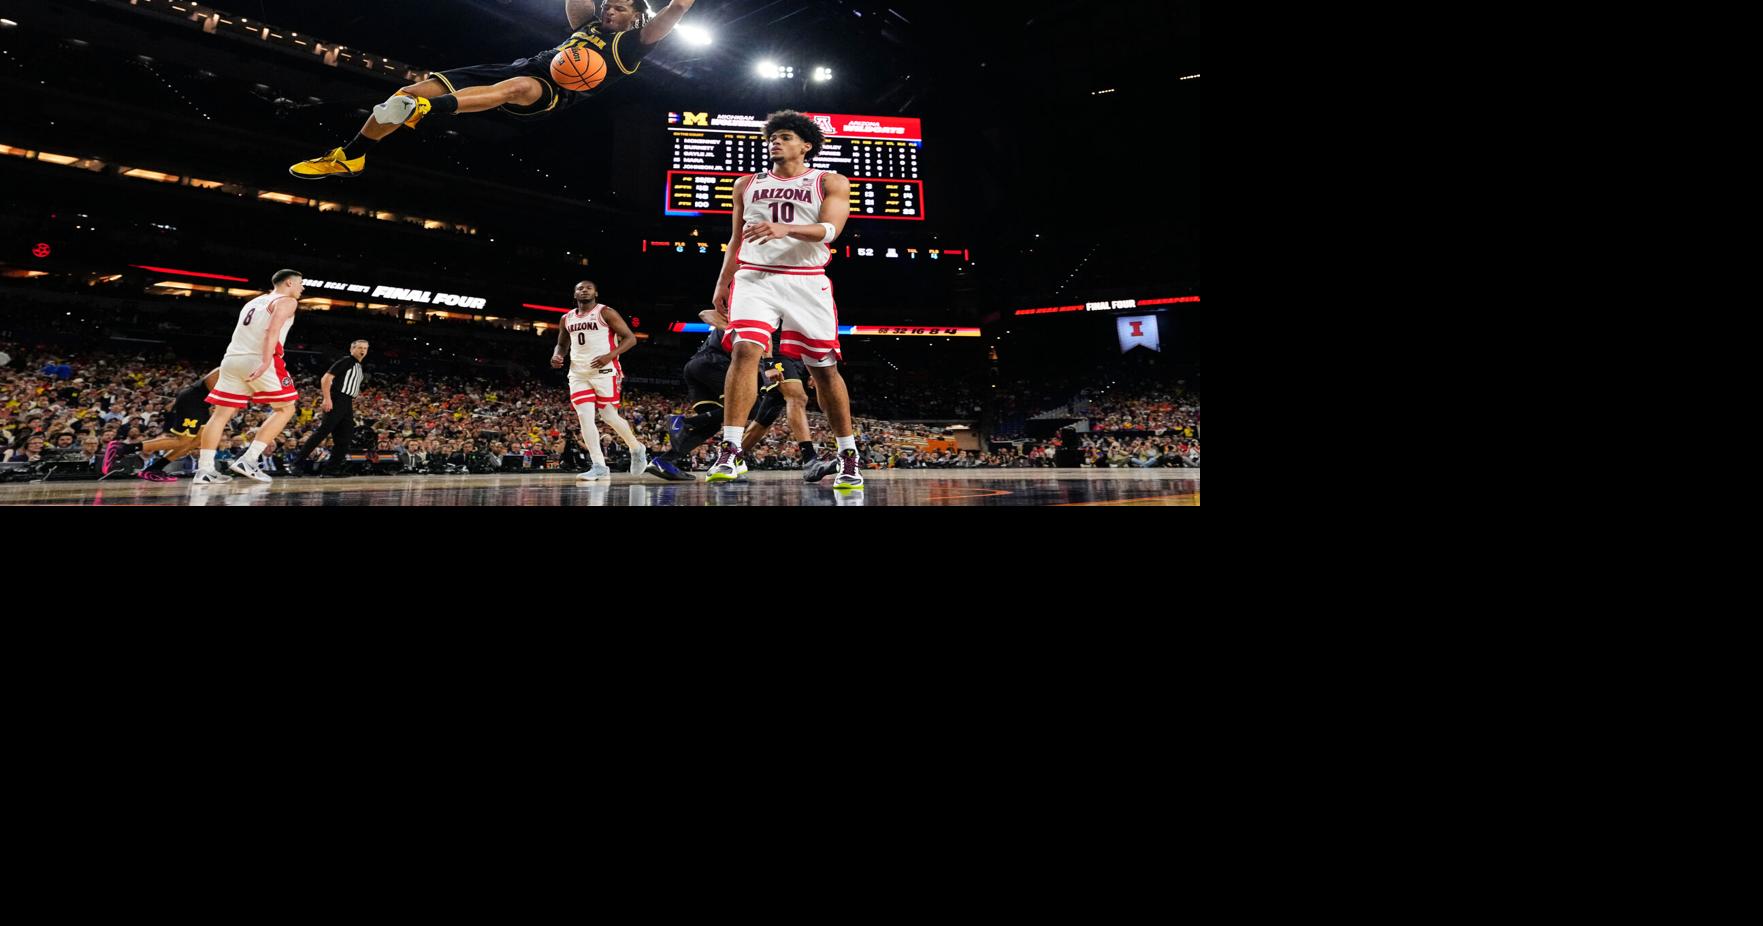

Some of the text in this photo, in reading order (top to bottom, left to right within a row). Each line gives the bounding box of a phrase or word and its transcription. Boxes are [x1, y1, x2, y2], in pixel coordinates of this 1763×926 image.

[682, 112, 708, 126] M
[843, 124, 905, 134] WILDCATS
[752, 188, 812, 204] ARIZONA
[768, 201, 794, 223] 10
[857, 248, 874, 256] 52
[372, 285, 433, 303] FINAL
[432, 293, 486, 310] FOUR
[1086, 301, 1111, 311] FINAL
[1112, 299, 1136, 309] FOUR
[242, 308, 255, 326] 8
[1129, 321, 1144, 337] I
[578, 332, 585, 345] 0
[183, 418, 198, 428] M
